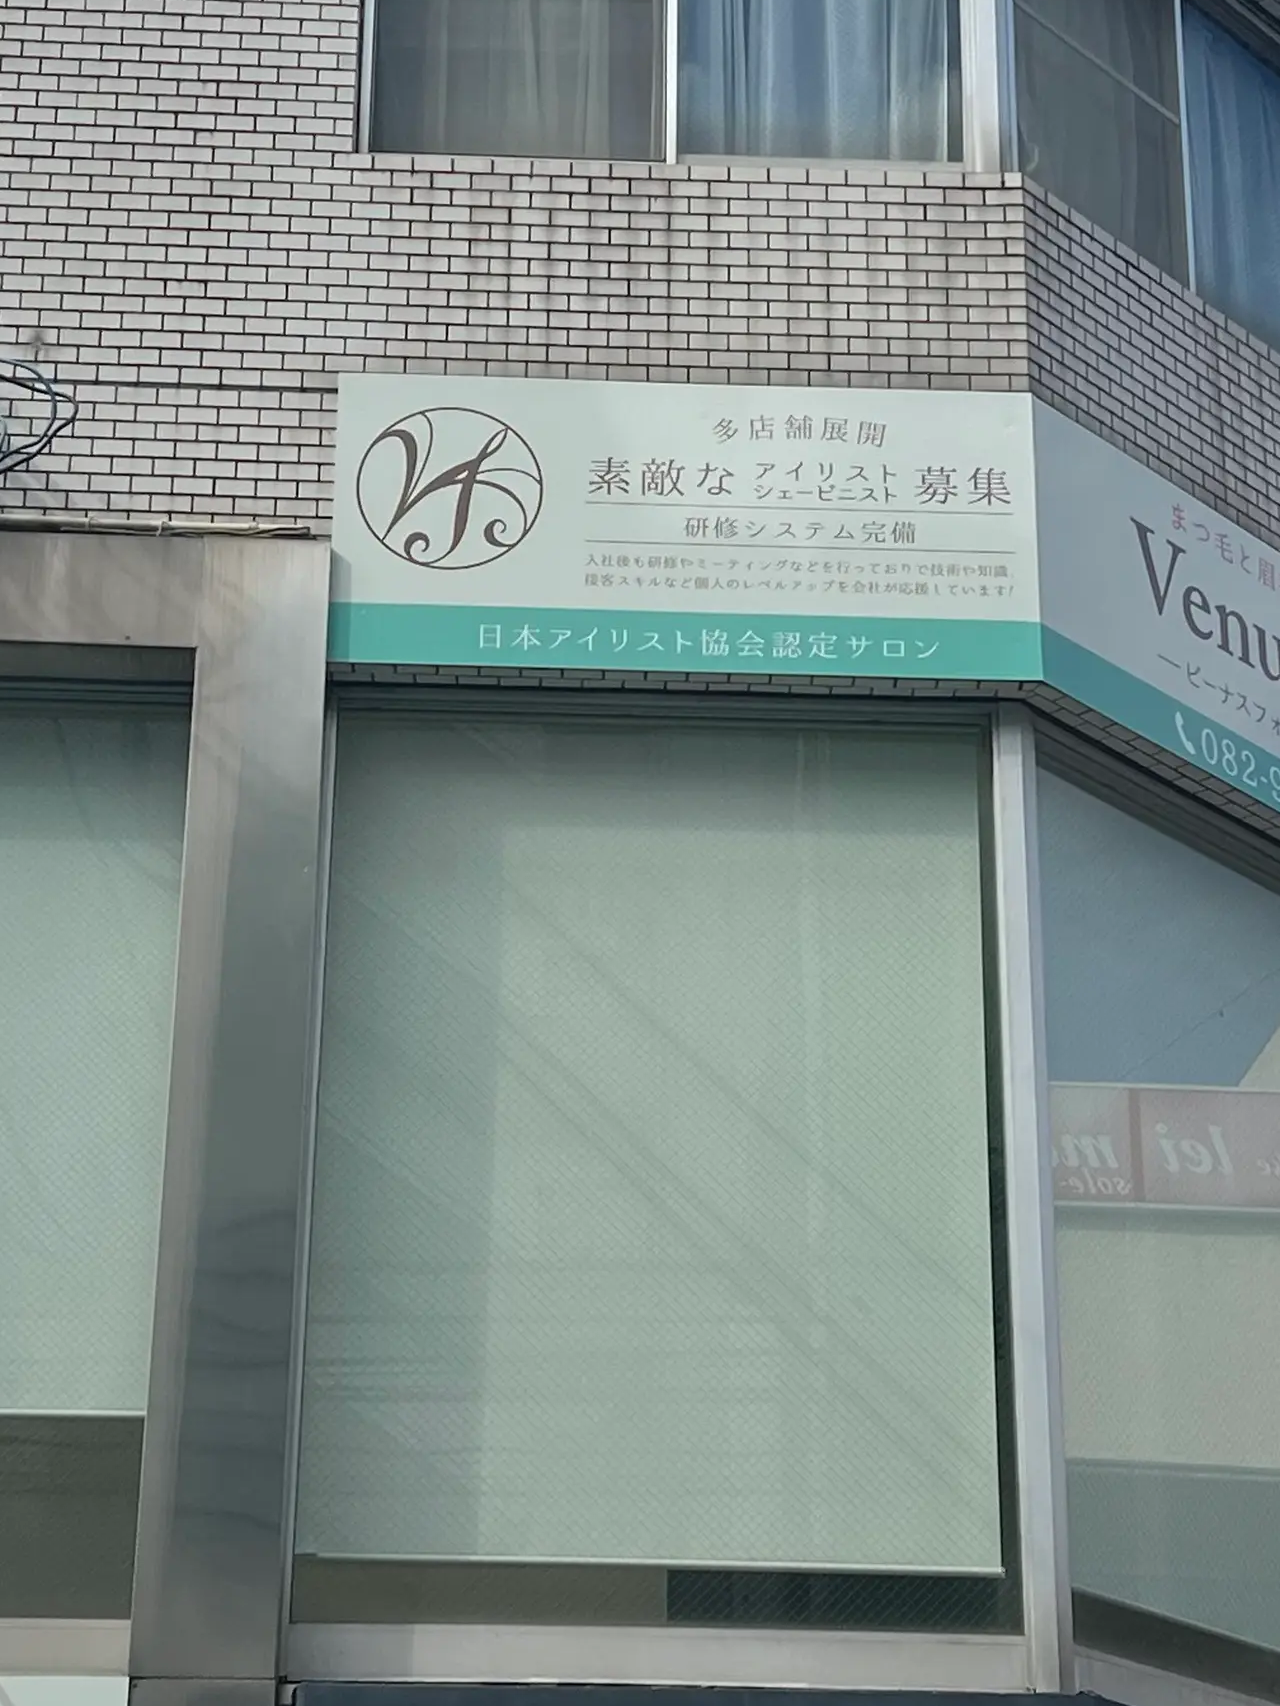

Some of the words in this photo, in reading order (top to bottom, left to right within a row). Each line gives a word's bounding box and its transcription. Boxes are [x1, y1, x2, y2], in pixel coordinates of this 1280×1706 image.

[712, 414, 887, 448] 多店舗展開
[587, 455, 736, 497] 素敵な
[755, 460, 898, 483] アイリスト
[916, 466, 1012, 506] 募集
[683, 515, 918, 545] 研修システム完備
[476, 622, 942, 661] 日本アイリスト協会認定サロン
